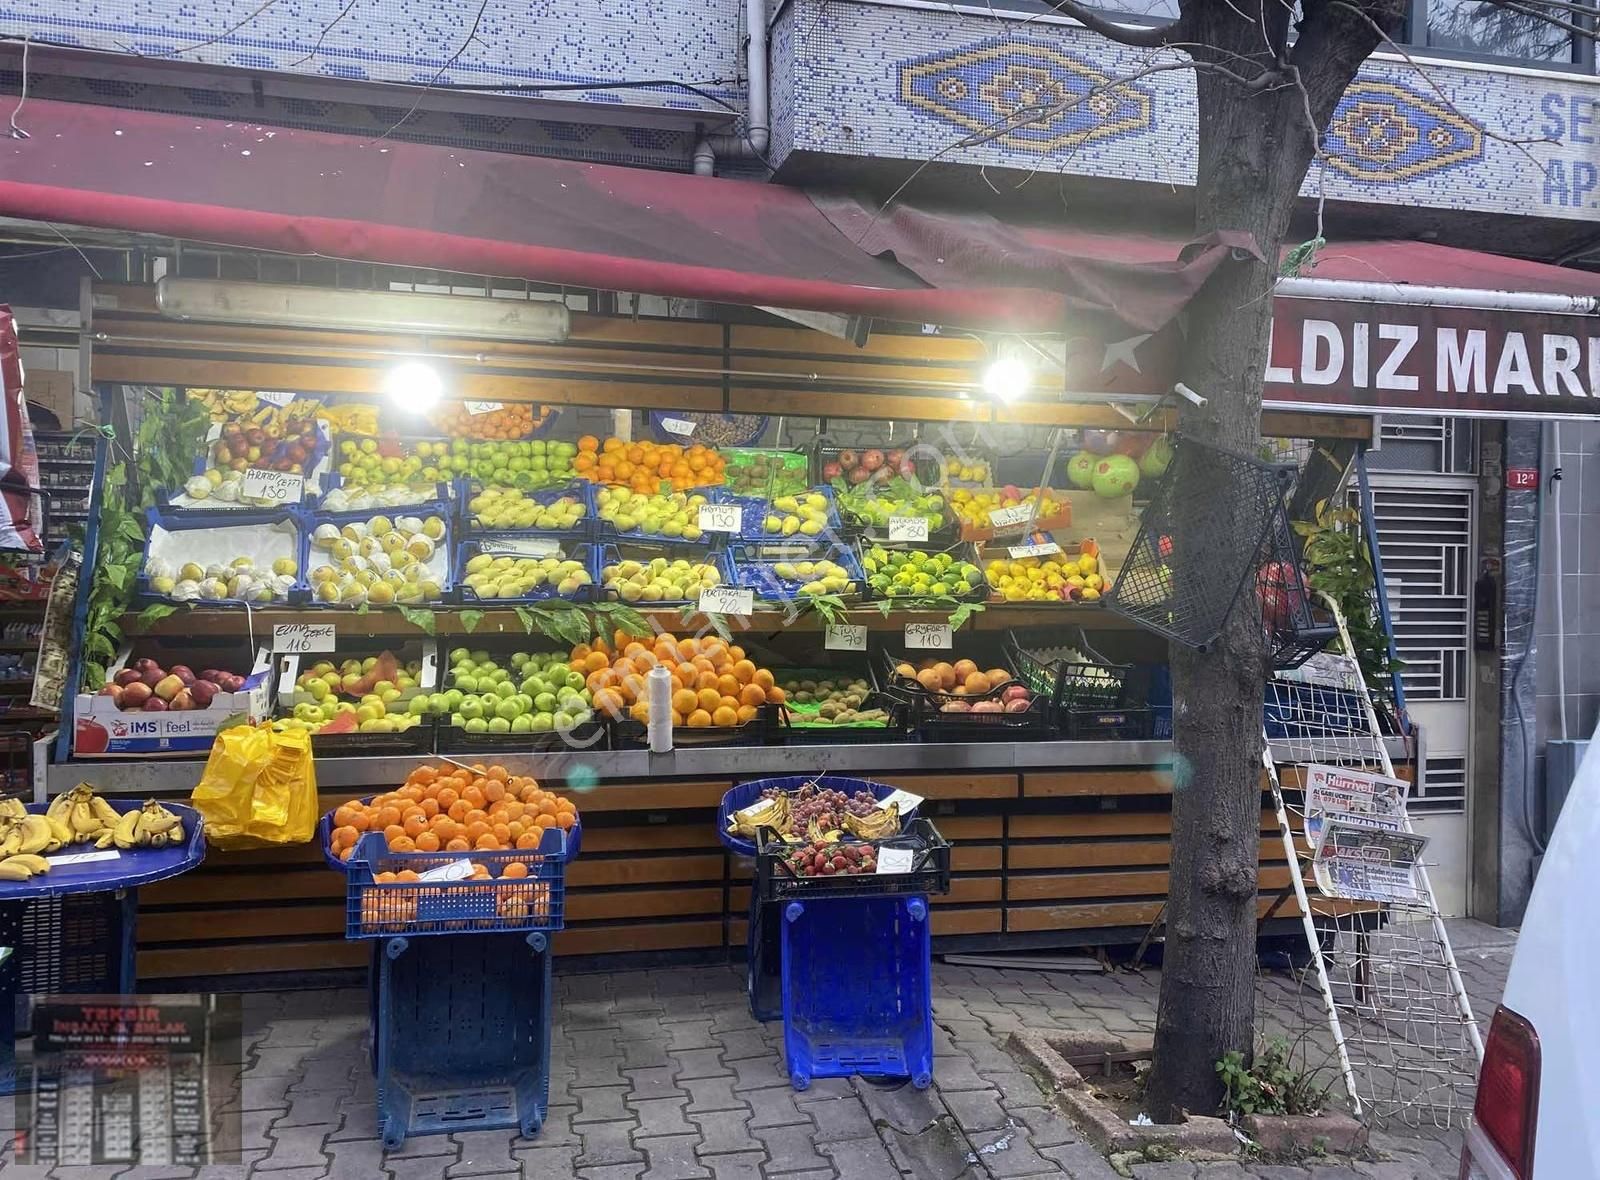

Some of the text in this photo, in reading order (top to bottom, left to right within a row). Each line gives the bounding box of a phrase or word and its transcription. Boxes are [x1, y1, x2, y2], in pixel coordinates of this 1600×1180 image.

[1263, 318, 1420, 391] LDIZ
[260, 486, 287, 499] 130
[712, 514, 735, 528] 130
[275, 624, 309, 637] ELMA
[286, 638, 312, 652] 110
[920, 633, 942, 648] 110
[166, 720, 191, 733] feel
